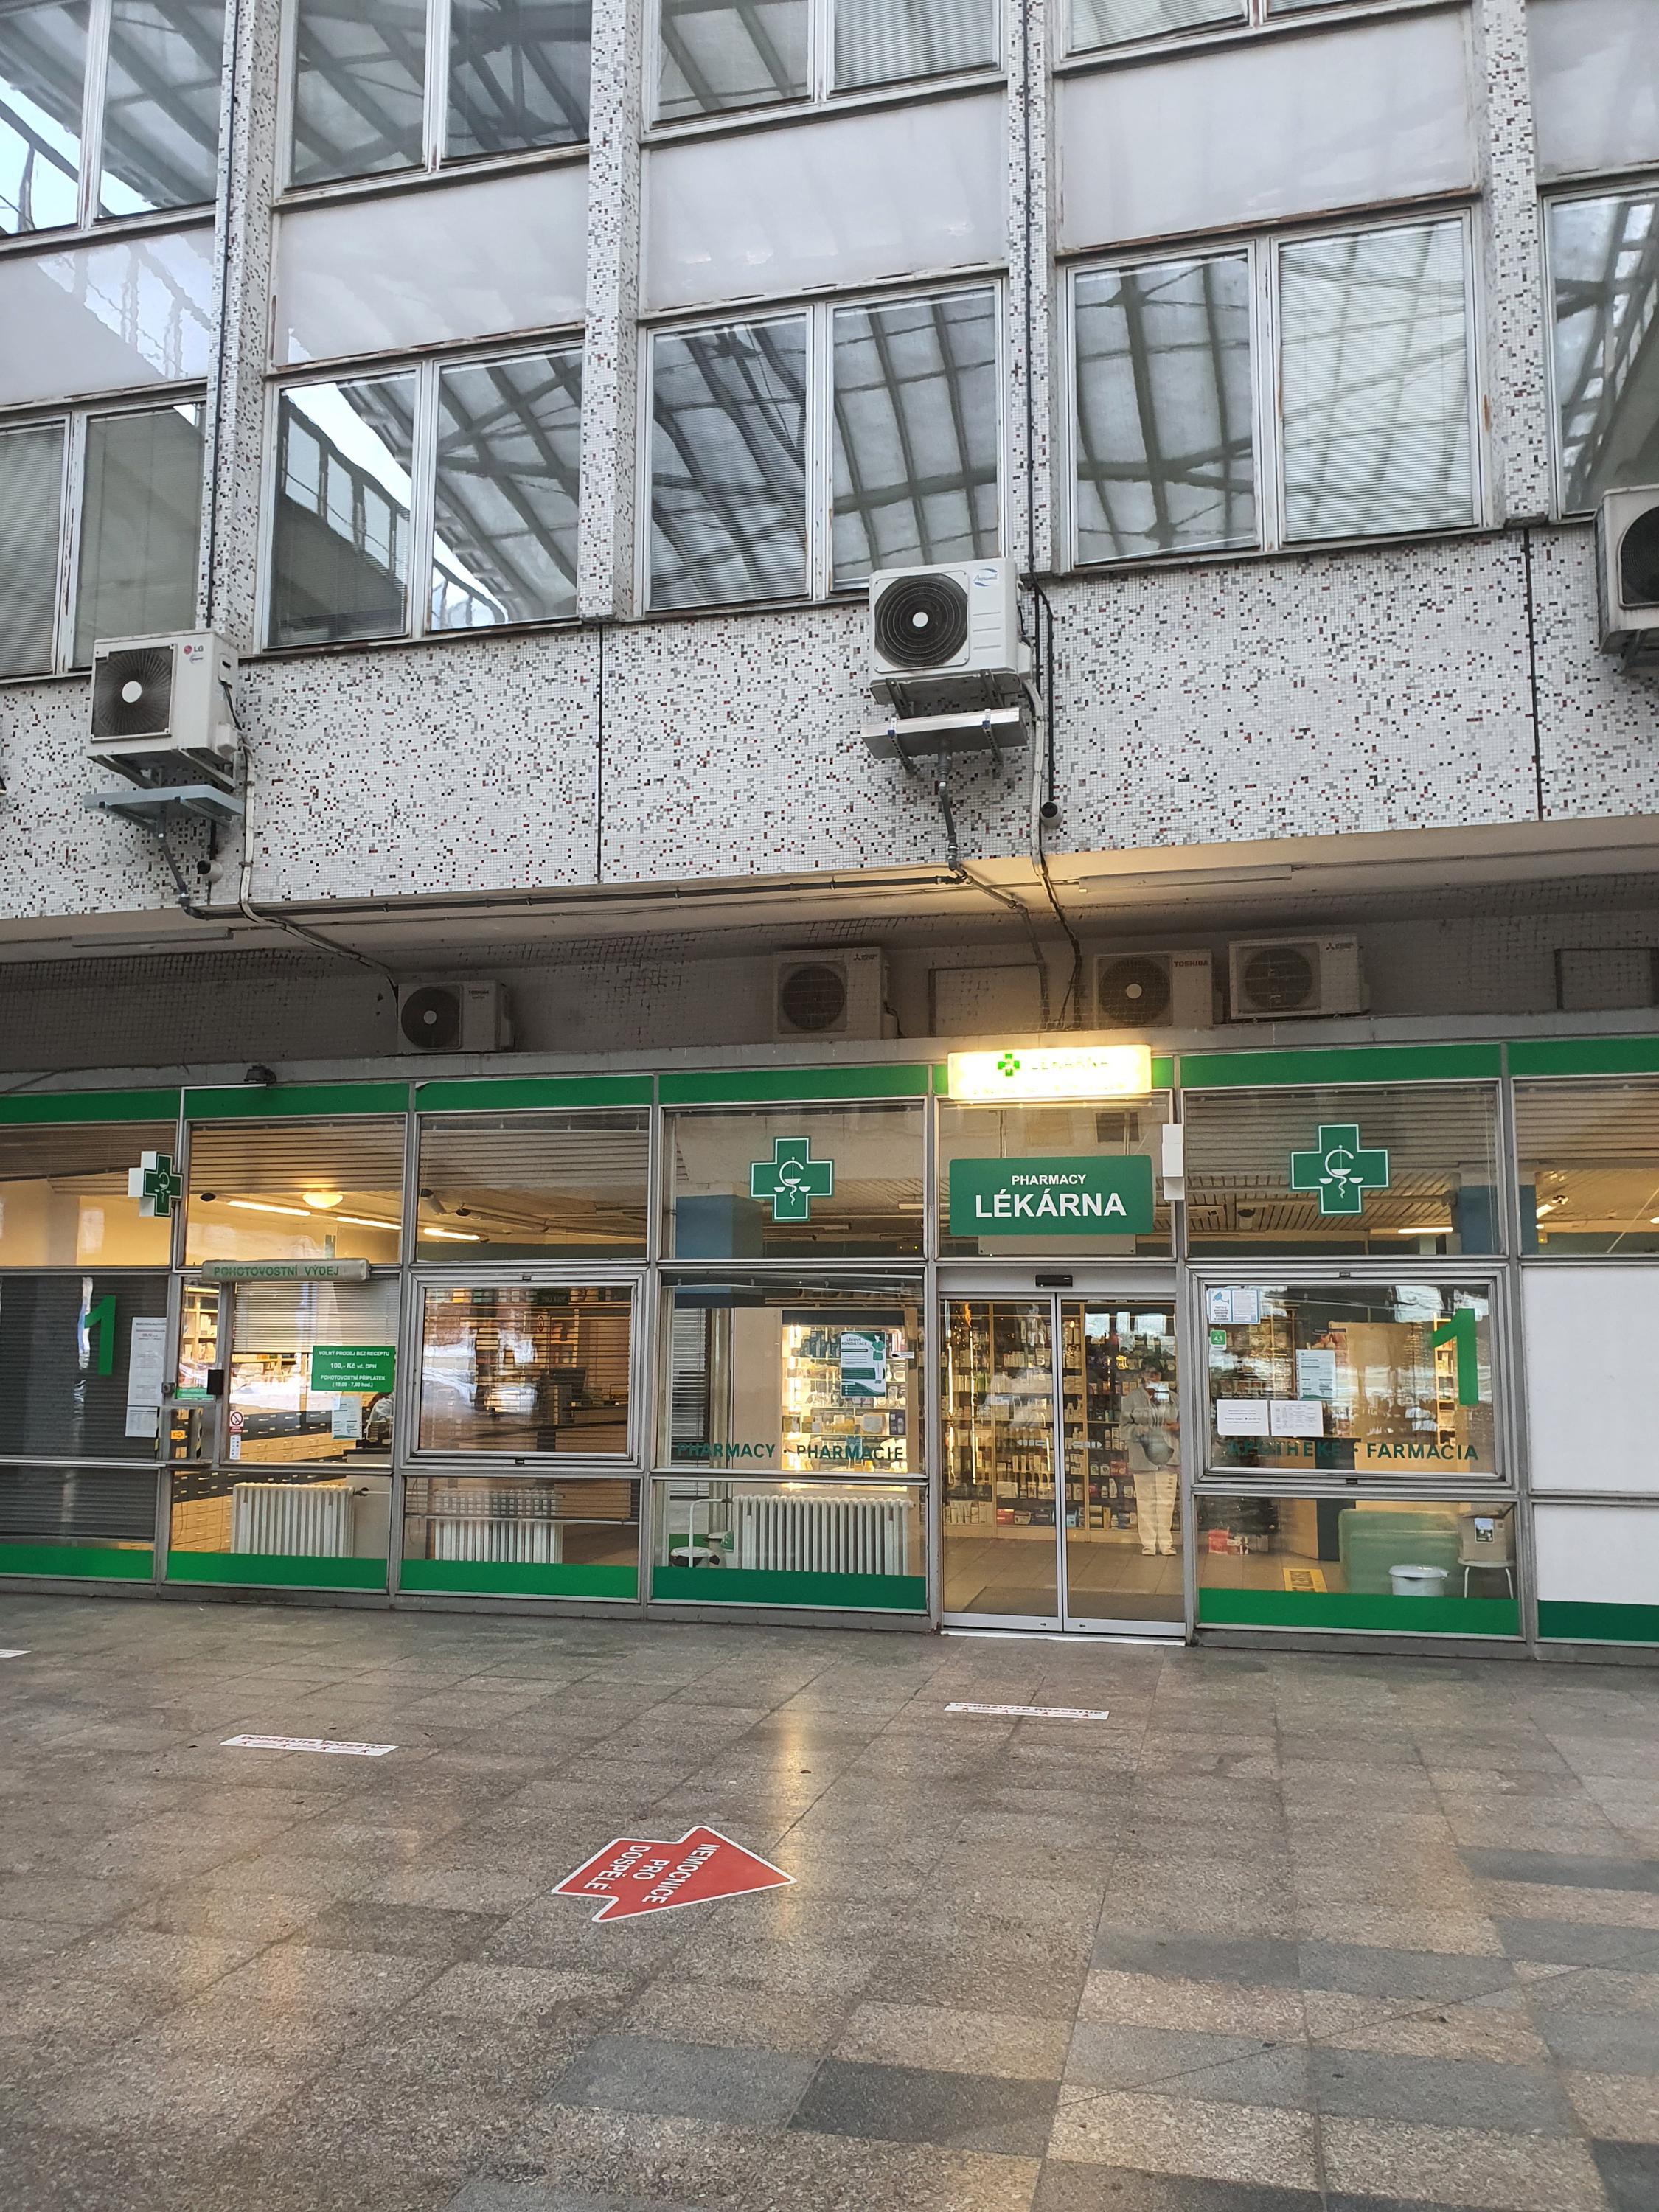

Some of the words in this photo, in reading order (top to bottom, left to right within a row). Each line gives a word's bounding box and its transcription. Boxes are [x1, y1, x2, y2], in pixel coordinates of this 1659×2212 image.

[1012, 1174, 1087, 1186] PHARMACY
[975, 1188, 1127, 1218] LÉKÁRNA
[214, 1264, 298, 1276] POHOTOVOSTNÍ
[305, 1264, 340, 1276] VÝDEJ
[678, 1443, 776, 1458] PHARMACY
[797, 1444, 904, 1461] PHARMACIE
[1367, 1442, 1479, 1460] FARMACIA
[583, 1845, 652, 1891] DOSPĚLÉ
[633, 1858, 670, 1881] PRO
[641, 1843, 721, 1904] NEMOCNICE
